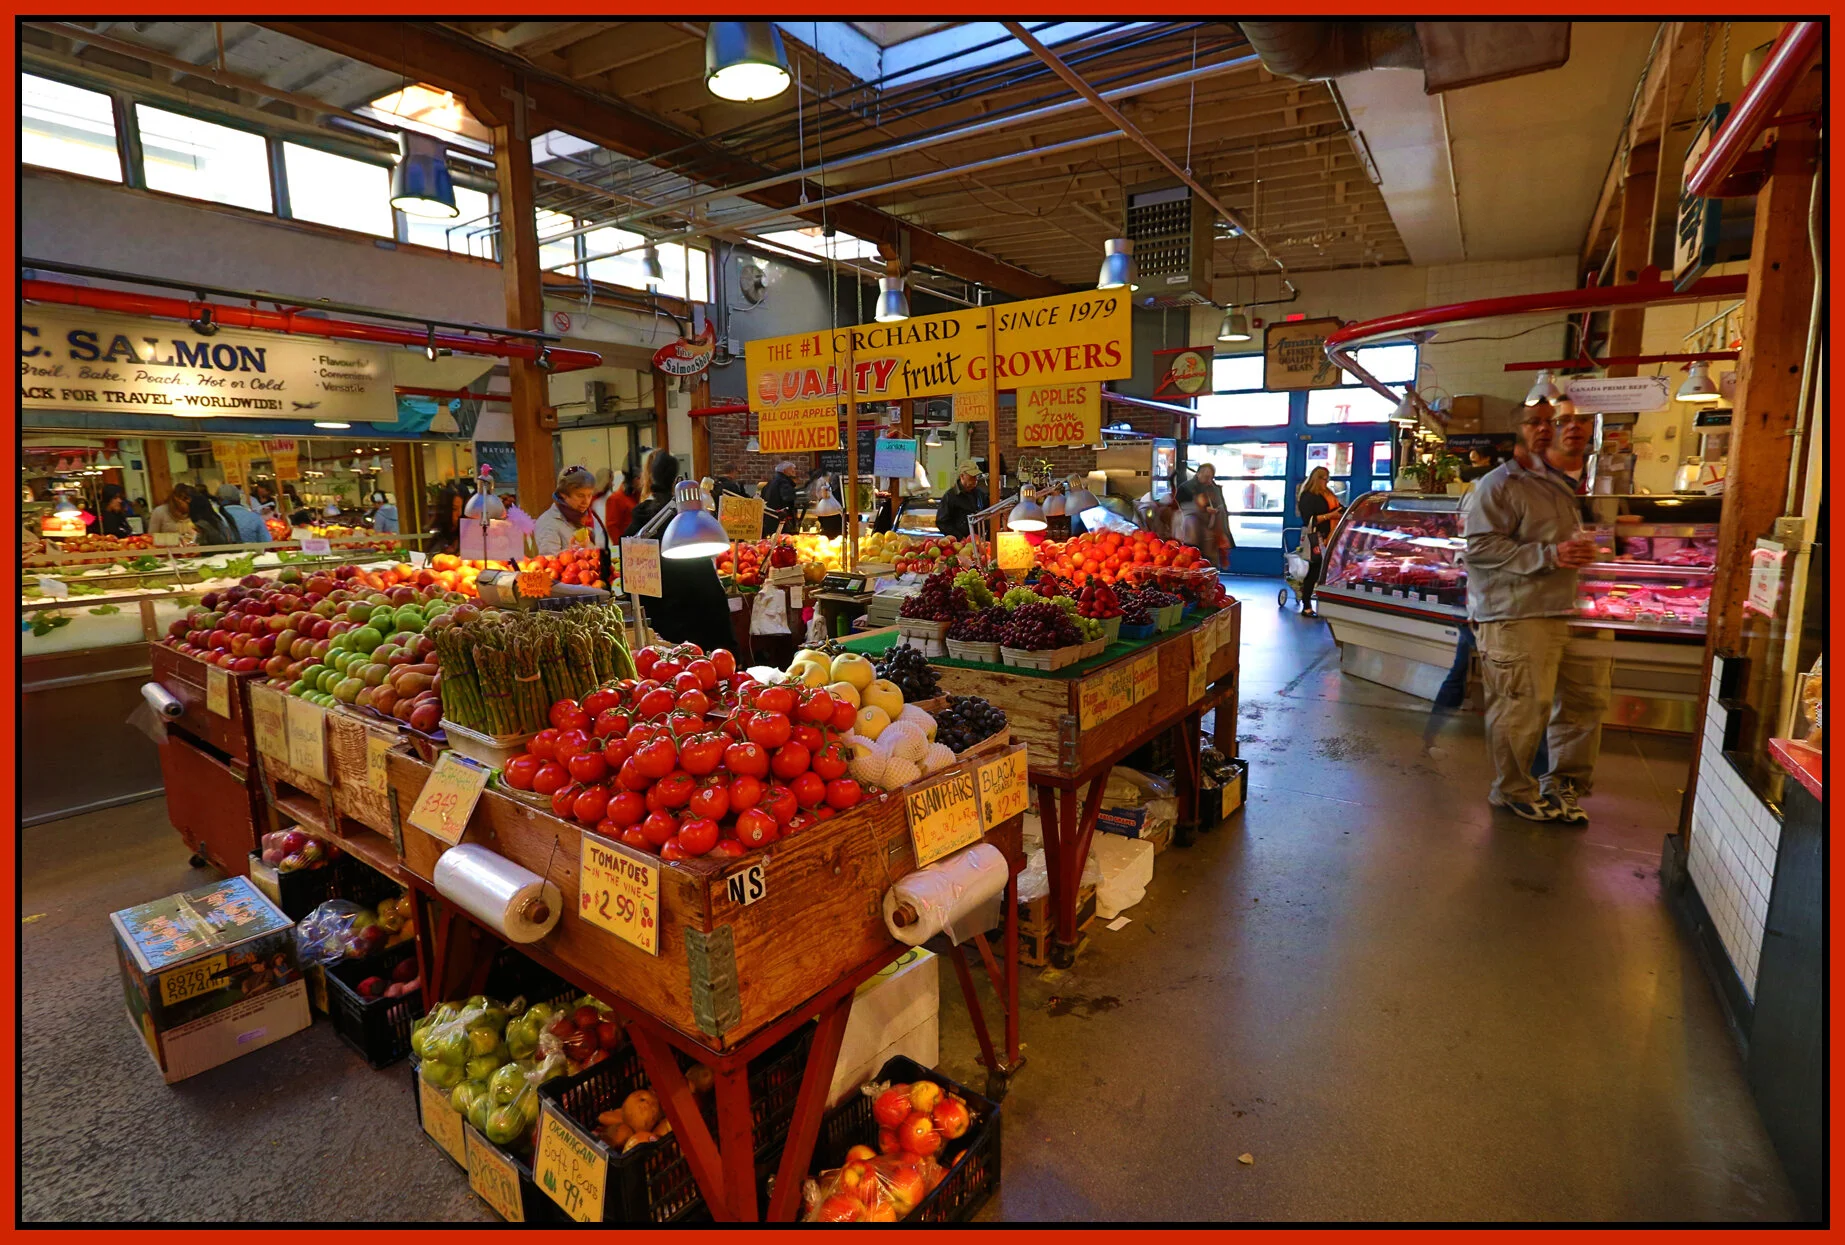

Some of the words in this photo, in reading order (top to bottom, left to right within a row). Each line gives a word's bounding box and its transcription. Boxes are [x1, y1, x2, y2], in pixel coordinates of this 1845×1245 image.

[767, 343, 793, 361] THE
[800, 334, 823, 357] #1
[998, 306, 1060, 332] SINCE
[1068, 298, 1117, 322] 1979
[67, 329, 267, 373] SALMON
[675, 346, 694, 358] The
[901, 352, 961, 397] fruit
[967, 340, 1122, 381] GROWERS
[61, 388, 99, 402] FOR
[197, 374, 226, 388] Hot
[230, 380, 245, 389] or
[250, 378, 287, 392] Cold
[321, 381, 366, 393] Versatile
[1028, 386, 1087, 407] APPLES
[761, 411, 778, 422] ALL
[780, 409, 800, 421] OUR
[801, 406, 837, 419] APPLES
[1036, 407, 1078, 422] From
[760, 425, 838, 451] UNWAXED
[1023, 421, 1085, 442] OSOYOOS
[981, 757, 1016, 793] BLACK
[909, 787, 942, 826] ASIAN
[941, 775, 974, 810] PEARS
[590, 847, 649, 887] TOMATOES
[592, 867, 600, 879] IN
[604, 871, 620, 887] THE
[623, 882, 642, 899] VINE
[544, 1135, 568, 1176] Soft
[571, 1158, 598, 1201] Pears
